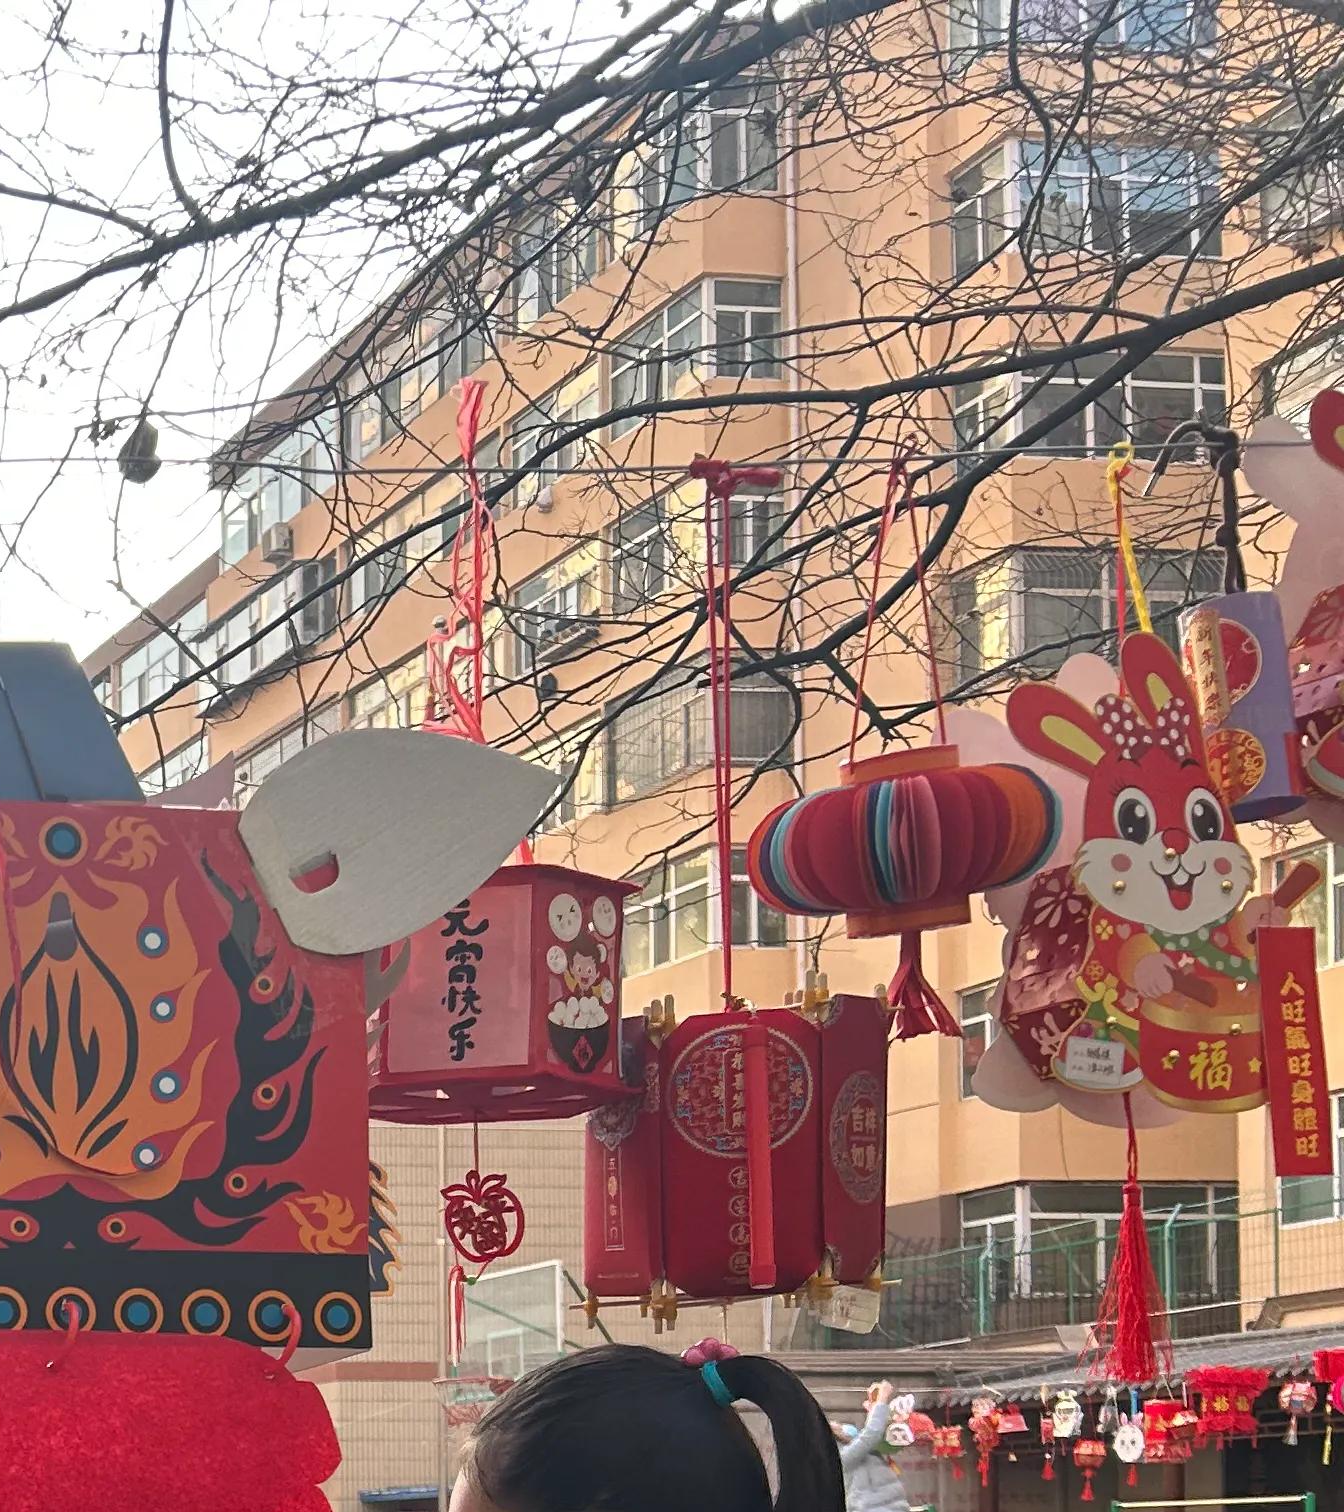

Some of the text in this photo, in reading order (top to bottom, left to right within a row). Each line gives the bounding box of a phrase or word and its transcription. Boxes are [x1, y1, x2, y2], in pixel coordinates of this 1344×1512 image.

[441, 898, 490, 1062] 元宵快乐
[1189, 1040, 1233, 1091] 福
